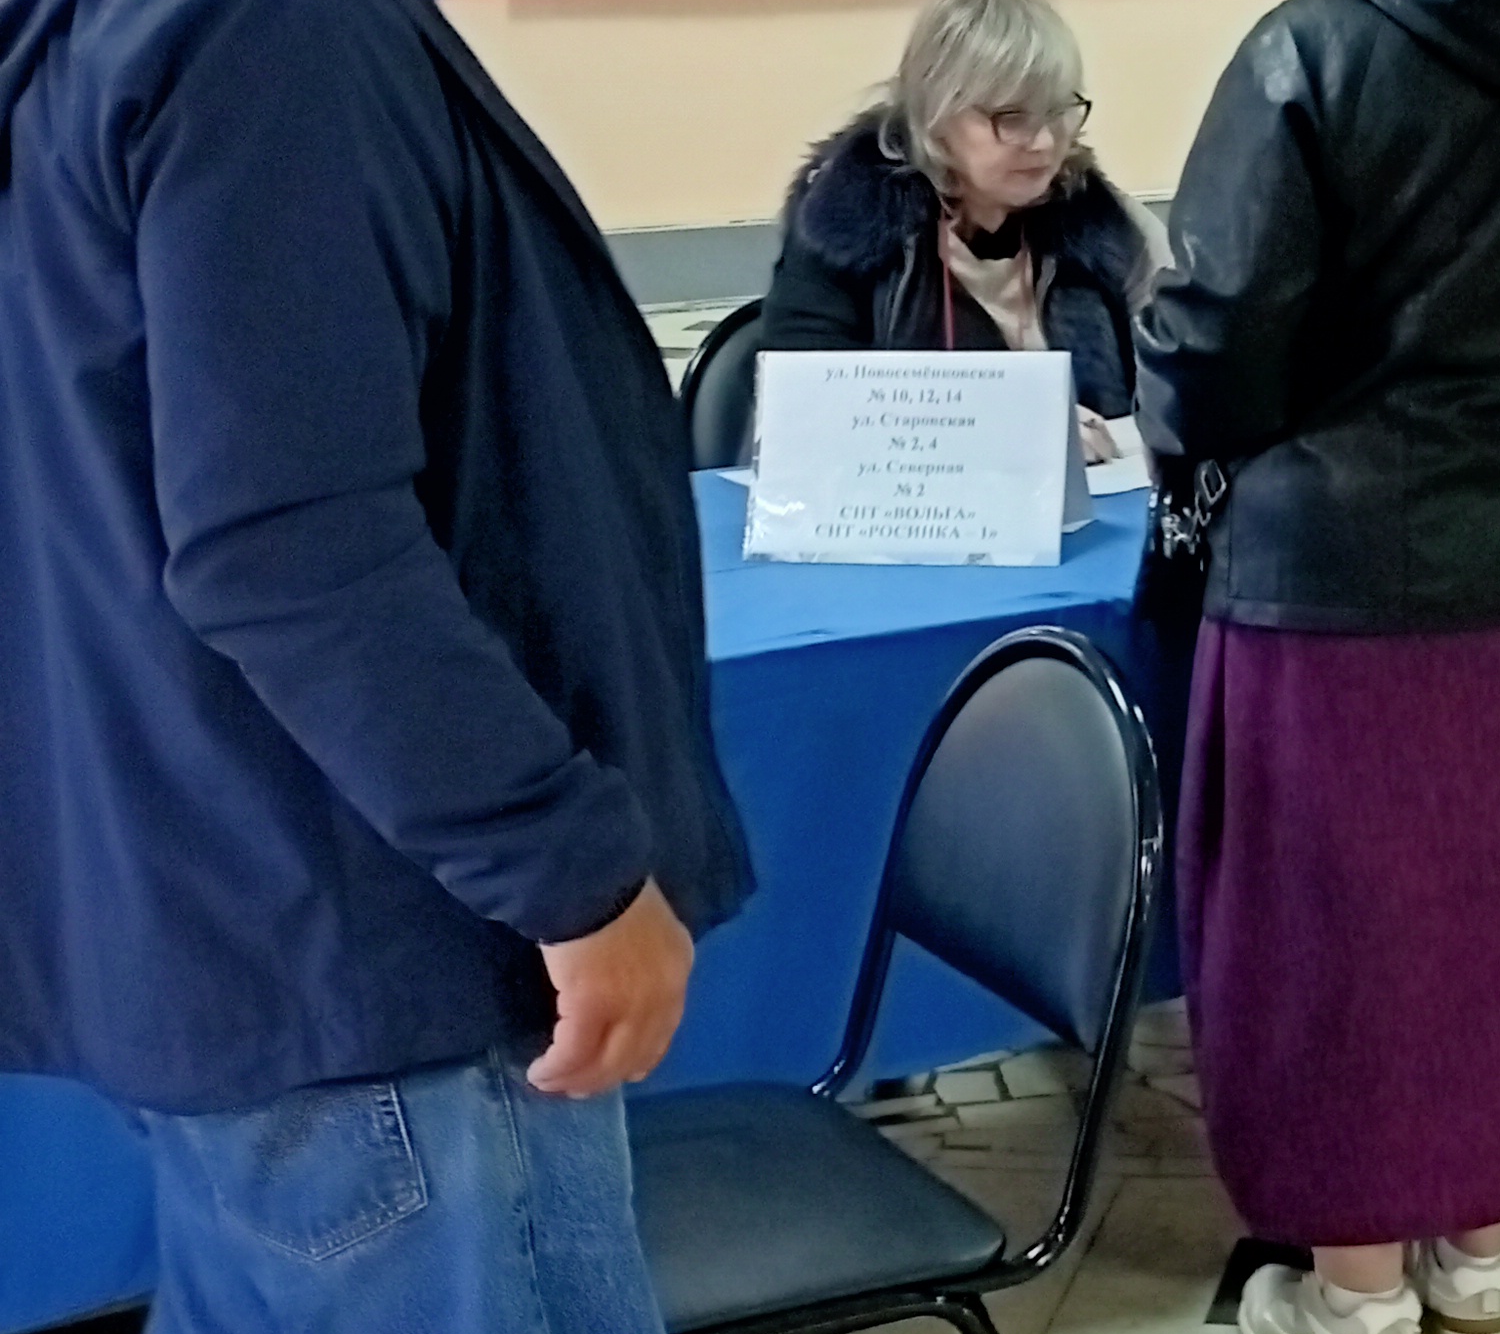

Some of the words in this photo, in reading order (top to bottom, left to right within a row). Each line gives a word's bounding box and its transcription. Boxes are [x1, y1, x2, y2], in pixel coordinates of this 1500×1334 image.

[826, 367, 848, 382] ул.
[867, 388, 886, 403] №
[892, 388, 913, 404] 10,
[919, 388, 940, 405] 12,
[946, 388, 963, 403] 14
[852, 415, 875, 430] ул.
[880, 412, 976, 430] Старовская
[888, 436, 906, 451] №
[929, 436, 938, 451] 4
[886, 460, 965, 477] Северная
[893, 483, 912, 497] №
[916, 483, 926, 497] 2
[839, 505, 880, 519] СНТ
[814, 523, 854, 538] СНТ
